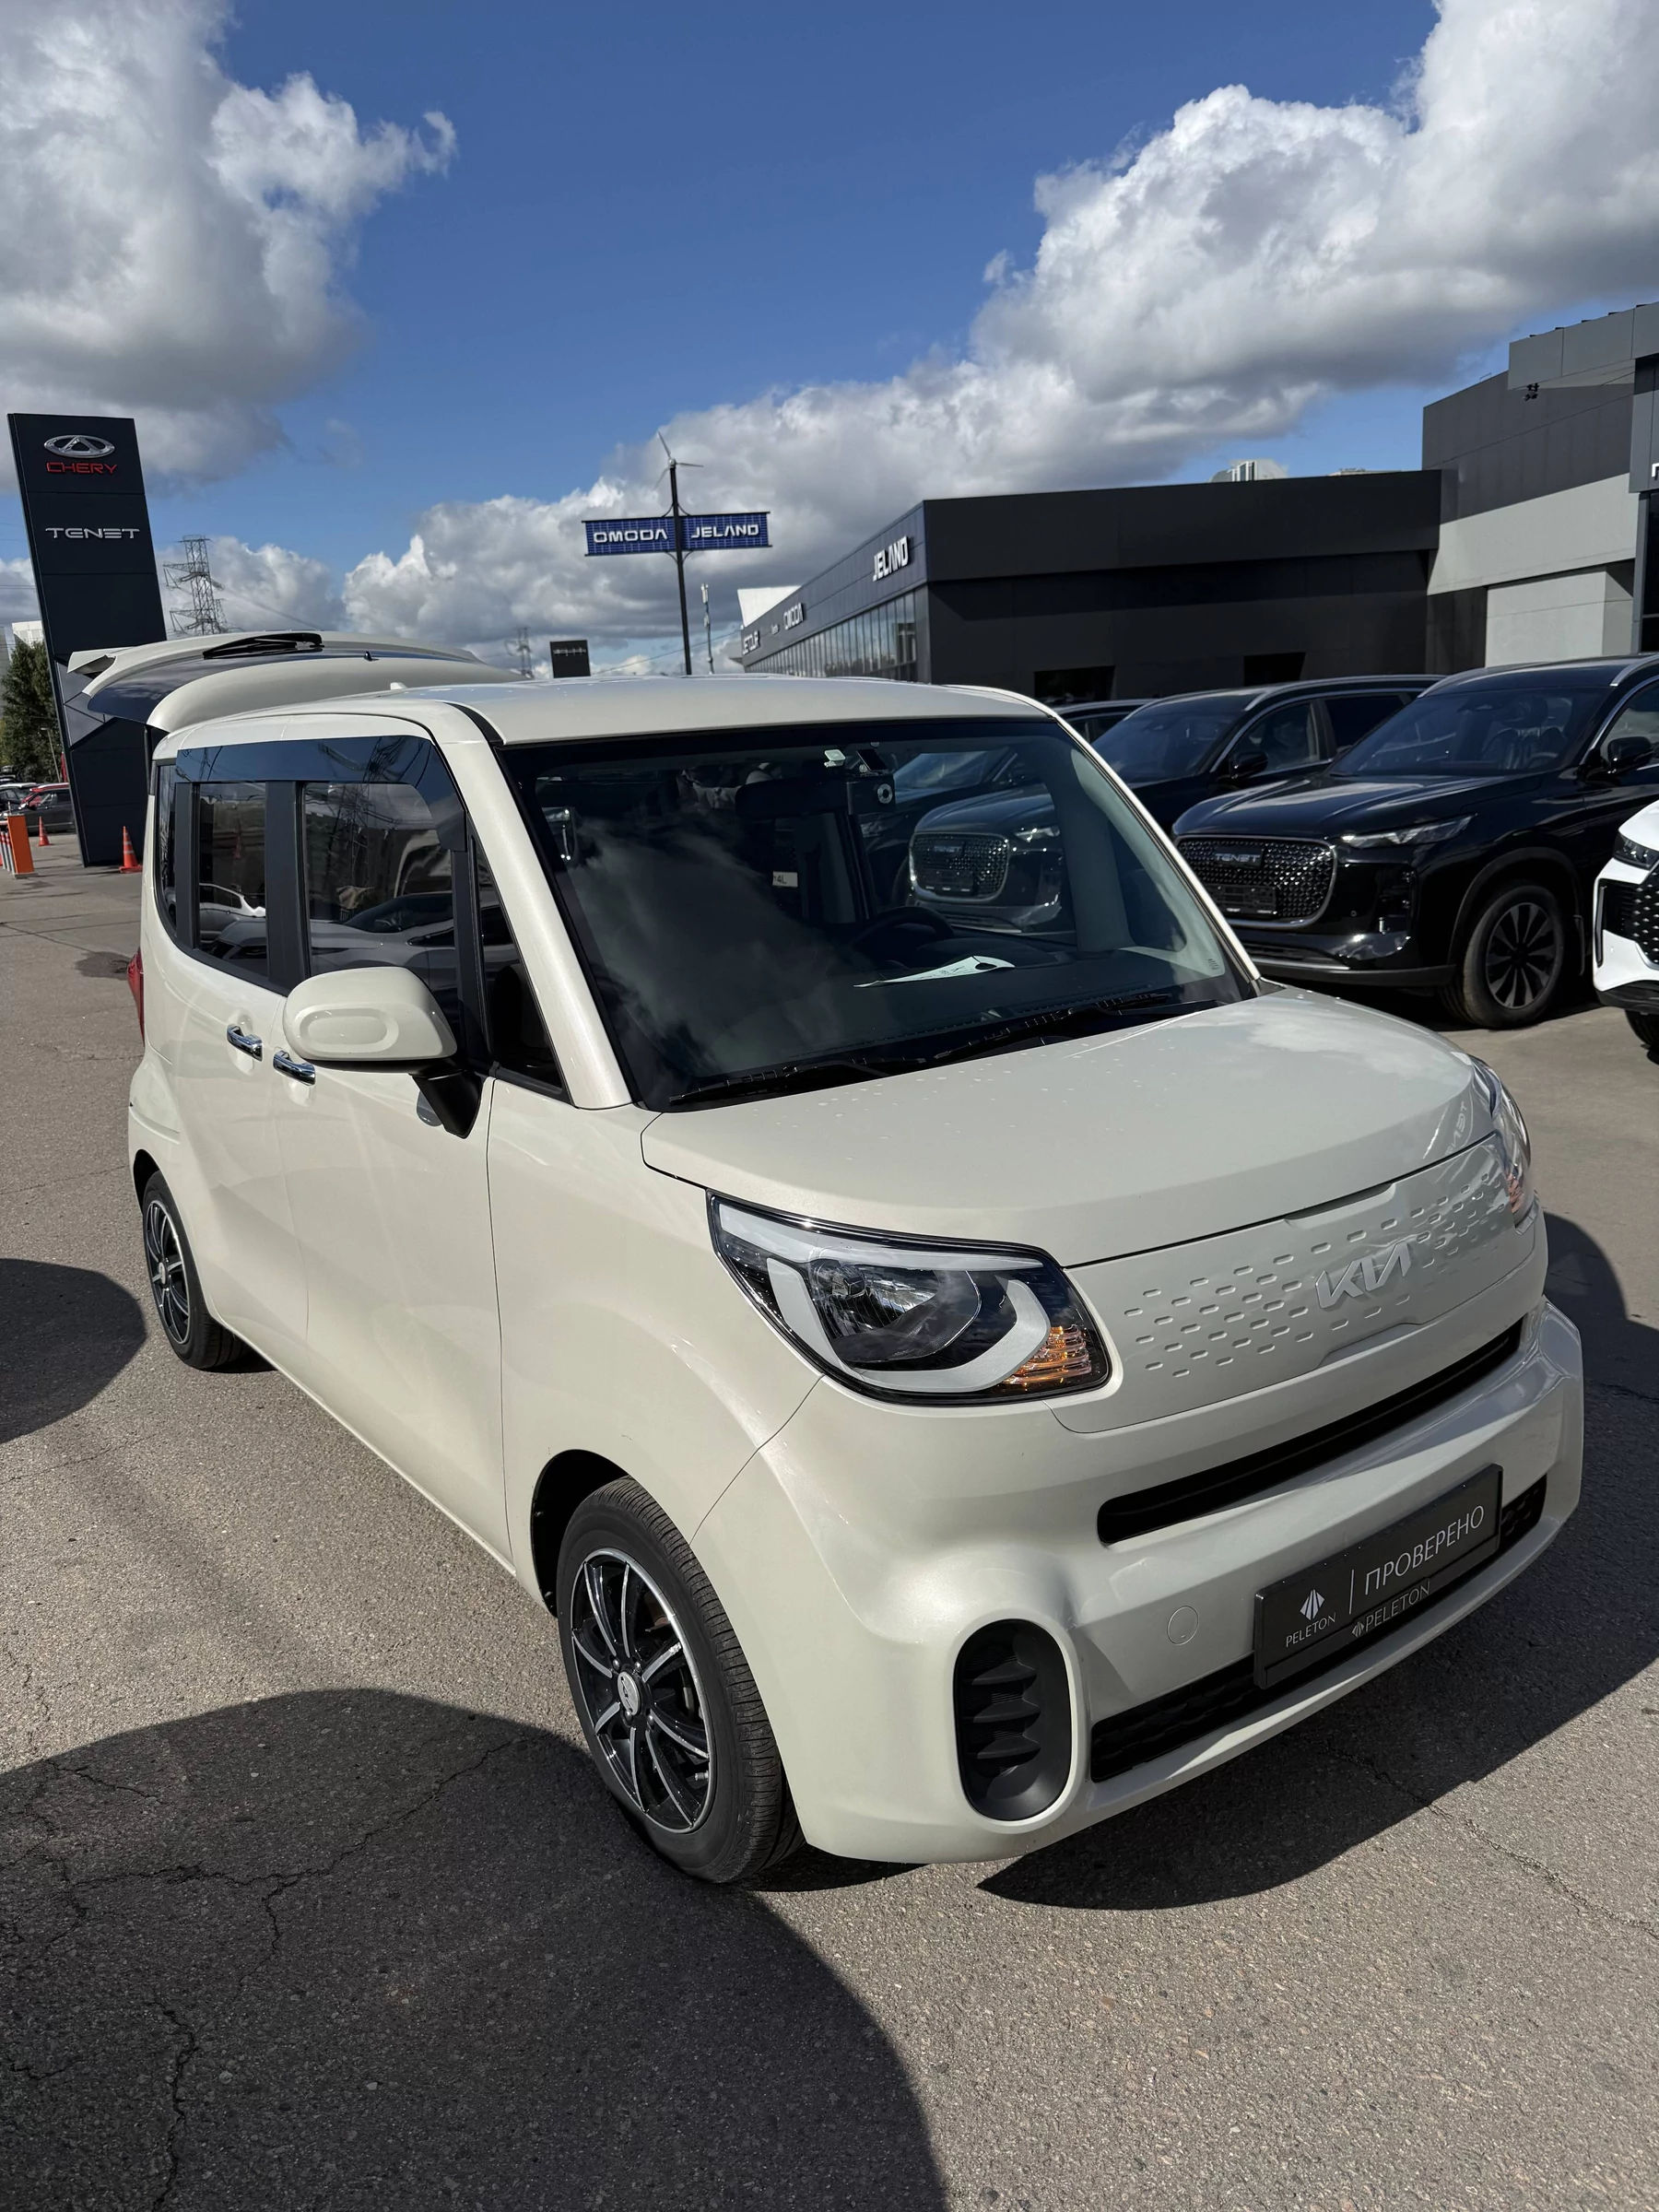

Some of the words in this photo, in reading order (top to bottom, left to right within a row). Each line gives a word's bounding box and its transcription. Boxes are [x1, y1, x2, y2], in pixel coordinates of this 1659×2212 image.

[46, 462, 117, 475] CHERY
[45, 527, 140, 538] TENET
[594, 528, 667, 543] OMODA
[691, 524, 759, 538] JELAND
[873, 535, 908, 582] JELAND
[783, 603, 803, 630] OMODA
[1215, 853, 1260, 863] TENET
[1315, 1242, 1411, 1309] KIA
[1365, 1505, 1484, 1595] ПРОВЕРЕНО
[1365, 1580, 1430, 1631] PELETON
[1286, 1612, 1336, 1647] PELETON
